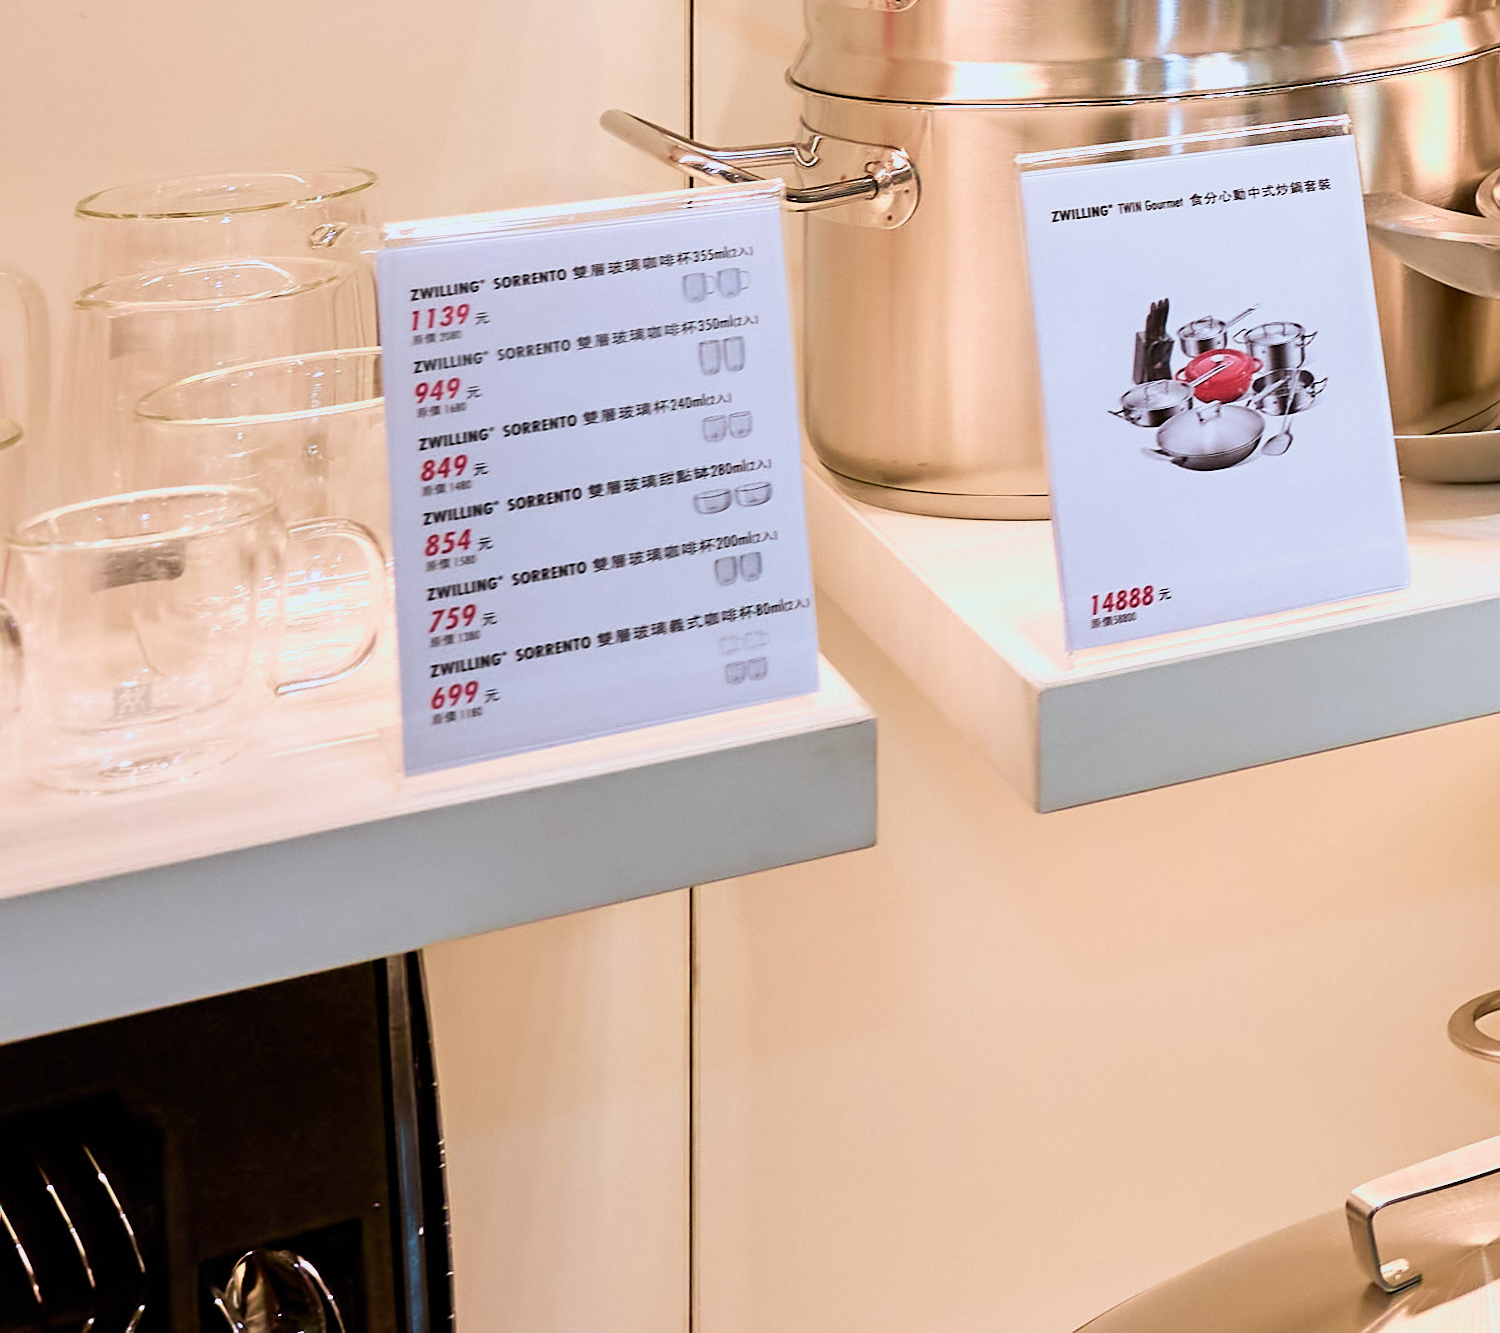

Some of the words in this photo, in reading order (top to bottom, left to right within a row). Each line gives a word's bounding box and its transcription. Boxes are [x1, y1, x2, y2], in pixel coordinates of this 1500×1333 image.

[1118, 200, 1142, 215] TWIN
[1145, 197, 1184, 212] Gourmet
[493, 268, 567, 290] SORRENTO
[411, 303, 470, 331] 1139
[497, 339, 571, 362] SORRENTO
[414, 376, 460, 404] 949
[503, 414, 577, 438] SORRENTO
[420, 454, 468, 483] 849
[507, 487, 582, 512] SORRENTO
[424, 528, 472, 557] 854
[512, 562, 587, 586] SORRENTO
[1091, 584, 1154, 615] 14888
[428, 603, 477, 633] 759
[515, 636, 591, 661] SORRENTO
[431, 681, 479, 711] 699
